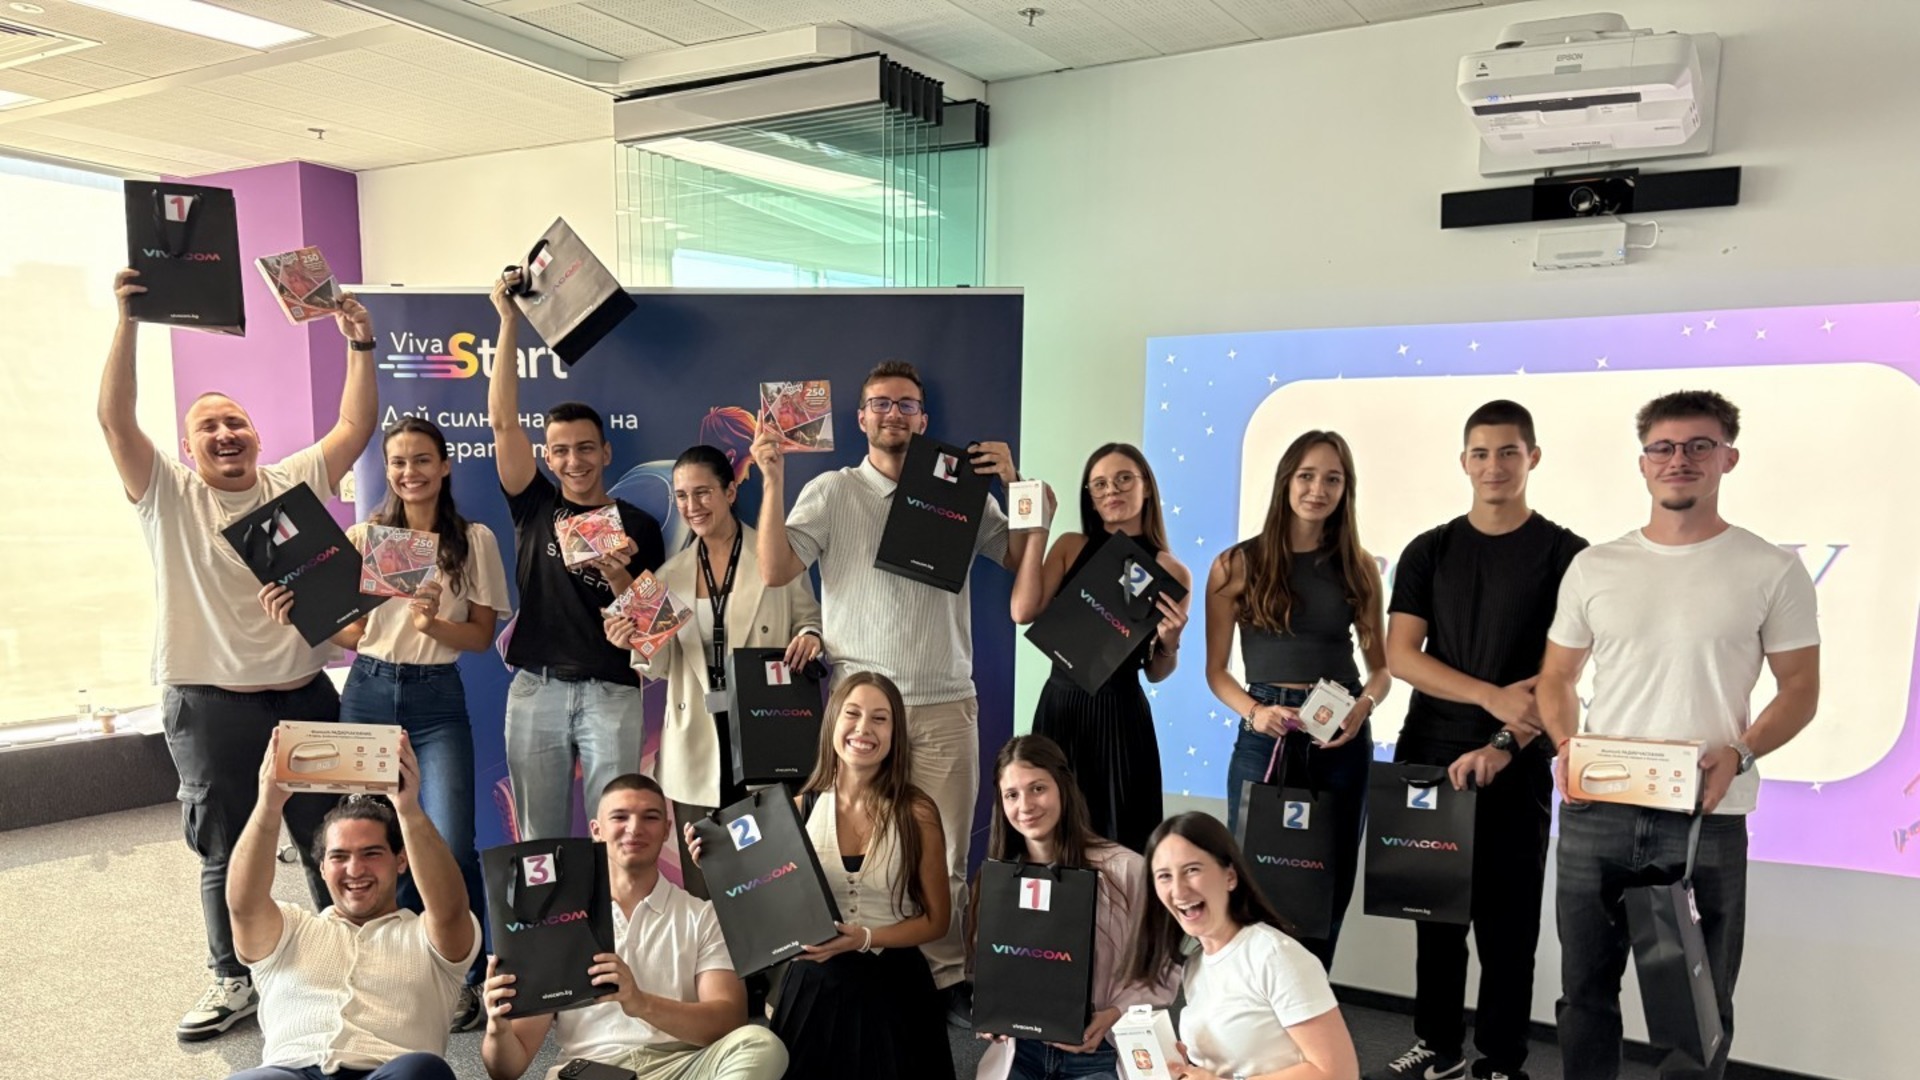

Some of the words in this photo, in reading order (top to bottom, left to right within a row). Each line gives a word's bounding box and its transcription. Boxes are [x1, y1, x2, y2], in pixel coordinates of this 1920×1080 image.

[1556, 53, 1584, 62] EPSON
[170, 196, 186, 221] 1
[390, 332, 443, 353] Viva
[806, 387, 825, 397] 250
[610, 414, 639, 429] на
[906, 495, 968, 523] VIVACOM
[413, 538, 433, 548] 250
[278, 546, 339, 585] VIVACOM
[1080, 588, 1131, 638] VIVACOM
[770, 661, 783, 684] 1
[750, 709, 813, 717] VIVACOM
[1286, 802, 1304, 828] 2
[731, 818, 756, 846] 2
[1381, 836, 1458, 851] VIVACOM
[527, 855, 549, 884] 3
[1256, 854, 1324, 870] VIVACOM
[725, 861, 798, 898] VIVACOM
[1026, 878, 1041, 909] 1
[992, 943, 1072, 962] VIVACOM
